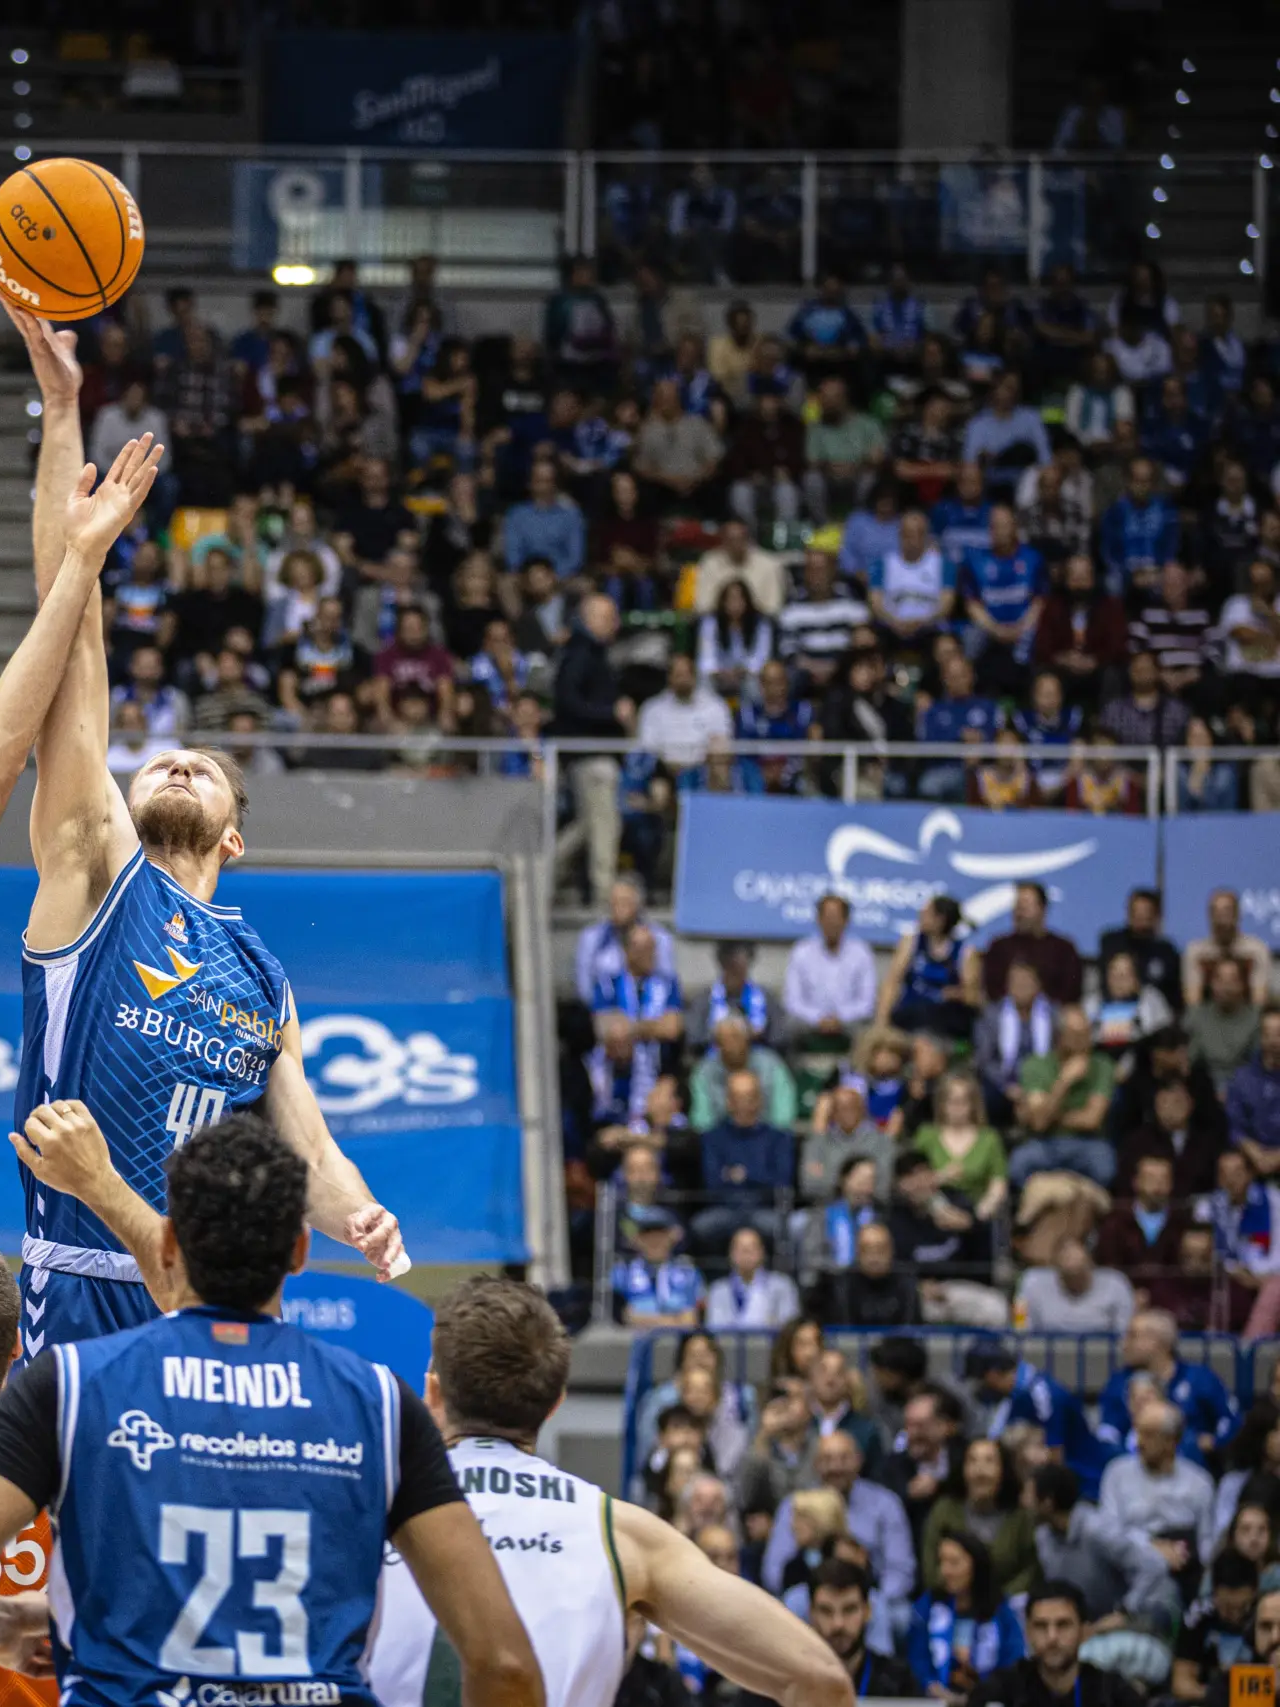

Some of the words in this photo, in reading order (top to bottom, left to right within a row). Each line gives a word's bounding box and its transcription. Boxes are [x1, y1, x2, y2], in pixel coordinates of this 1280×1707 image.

[10, 204, 38, 241] acb
[162, 1356, 312, 1408] MEINDL
[180, 1431, 297, 1458] recoletas
[301, 1437, 363, 1466] salud
[457, 1465, 576, 1503] NOSKI
[157, 1503, 313, 1677] 23
